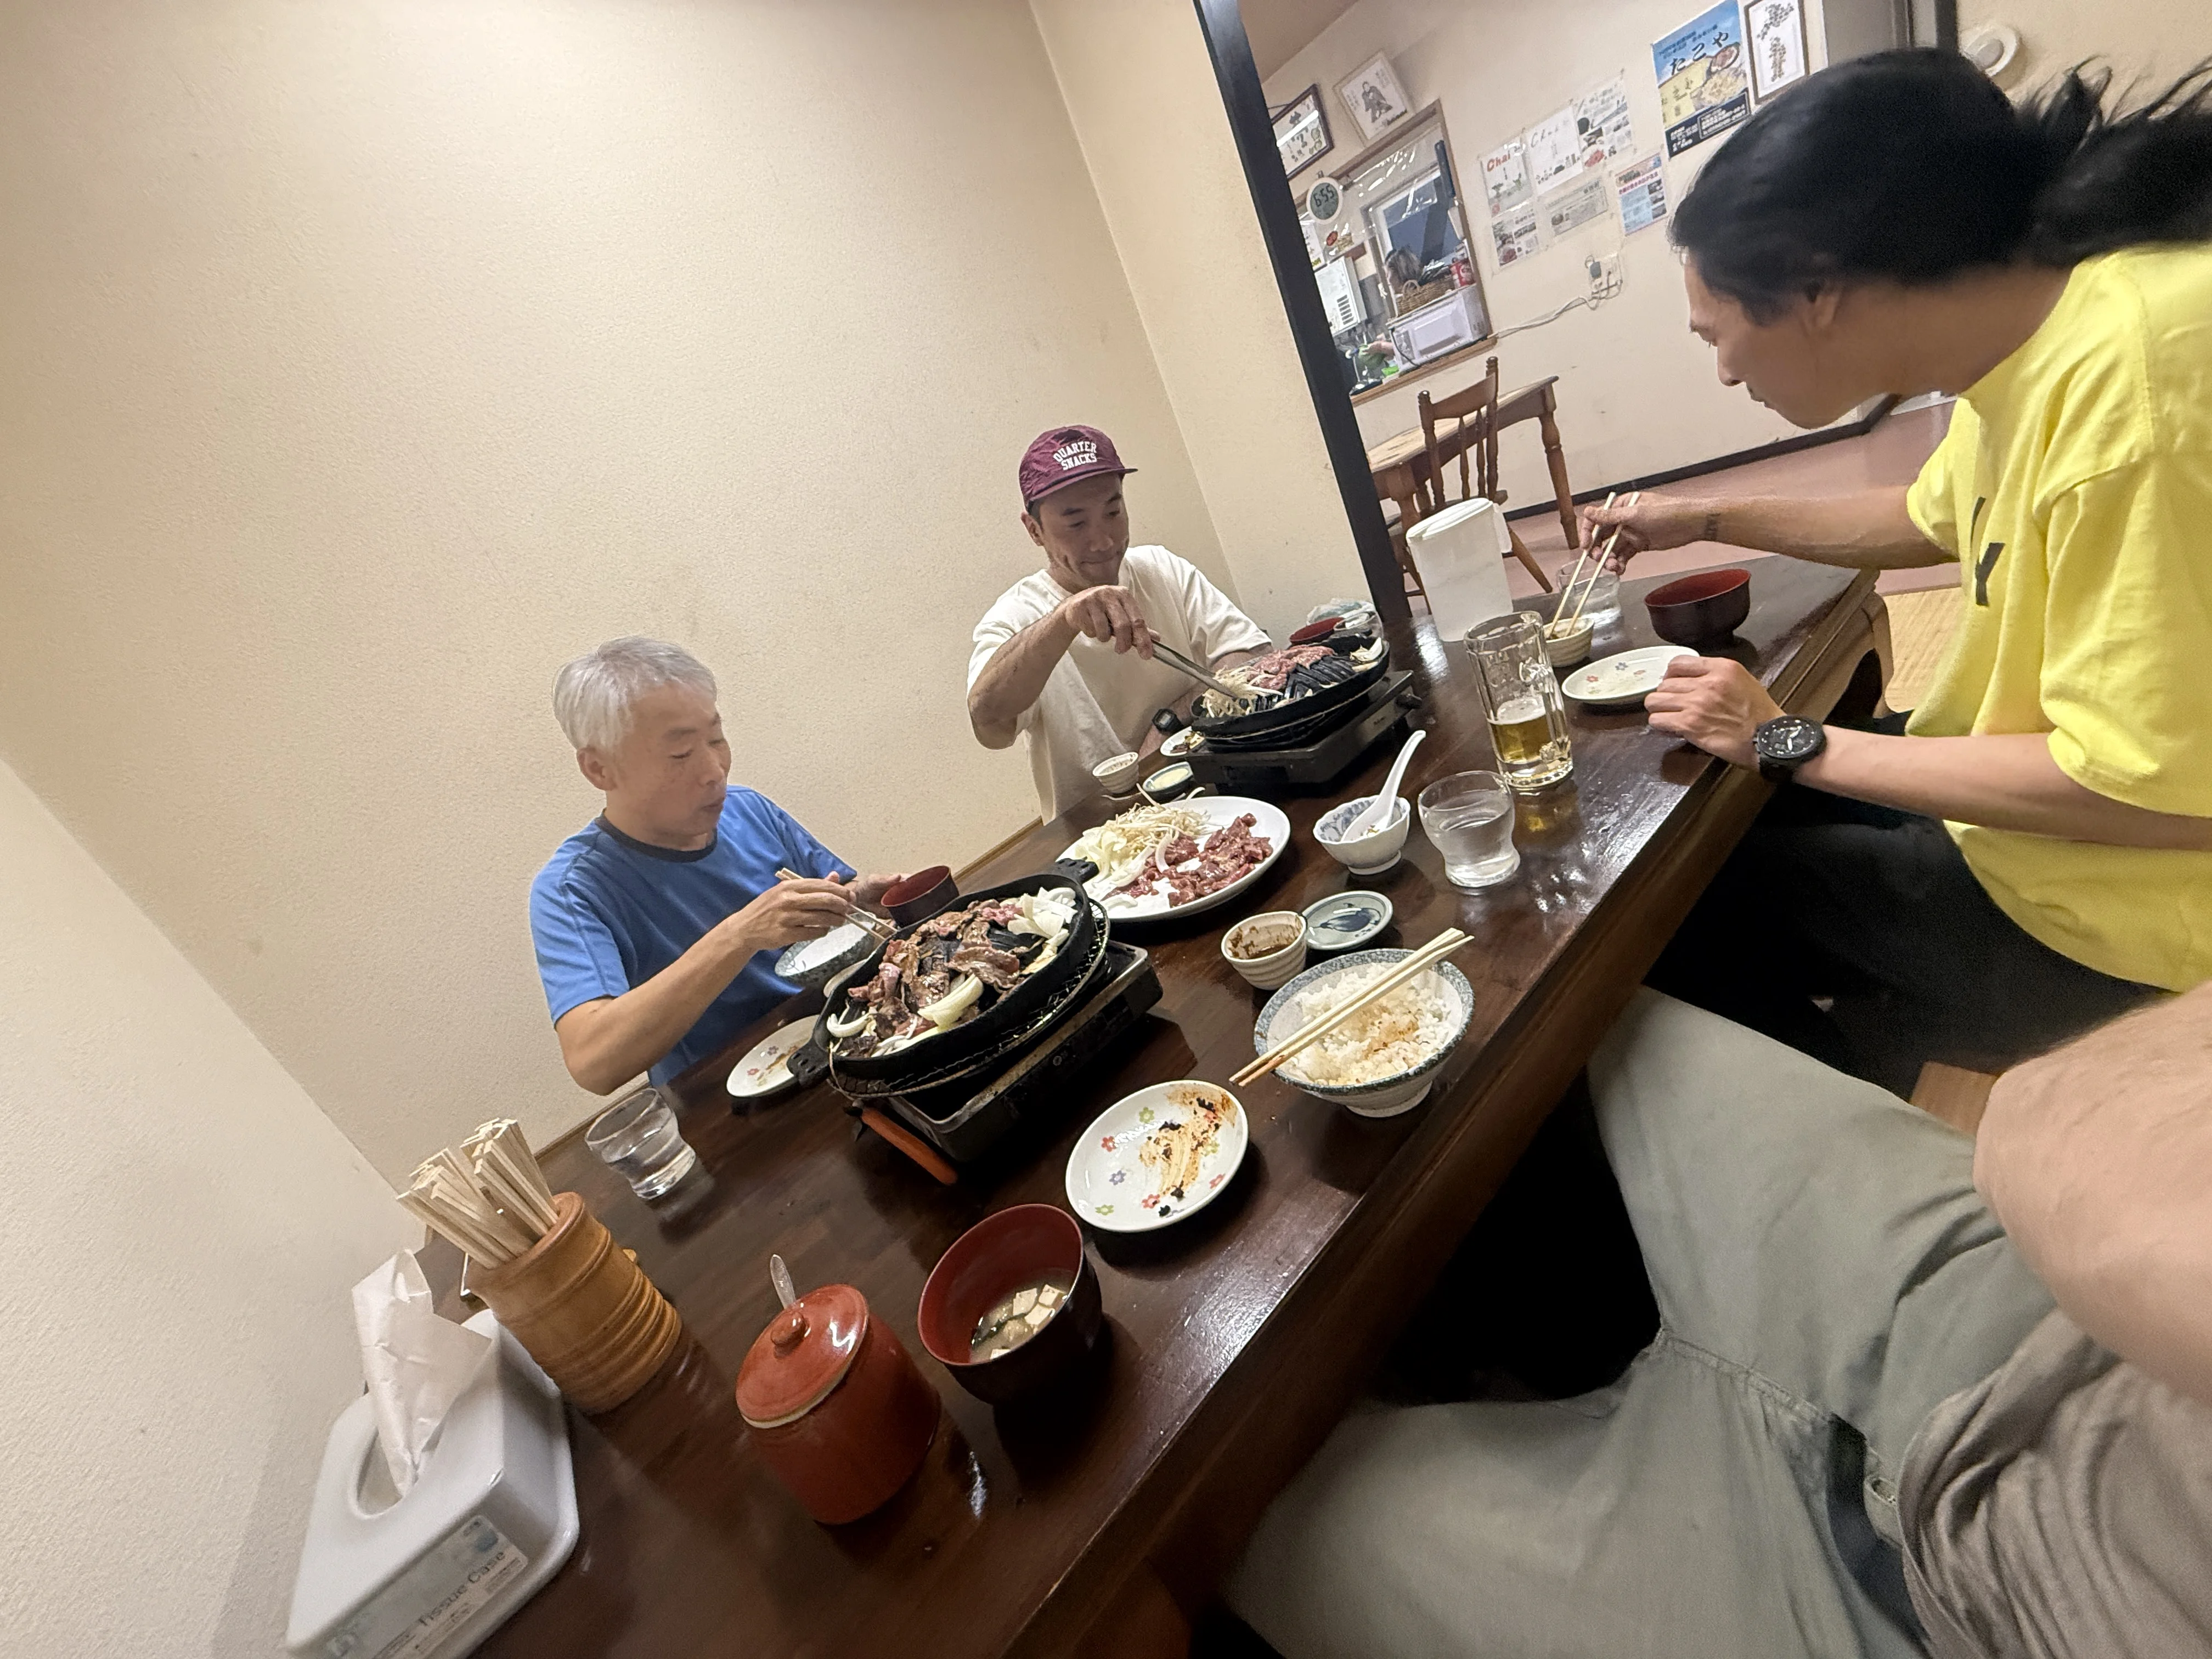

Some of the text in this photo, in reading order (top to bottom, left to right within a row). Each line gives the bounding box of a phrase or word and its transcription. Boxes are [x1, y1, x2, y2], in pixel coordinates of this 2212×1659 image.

[1053, 441, 1097, 462] QUARTER
[1061, 453, 1097, 470] SNACKS
[419, 1584, 467, 1626] Tissue
[469, 1551, 505, 1583] Case
